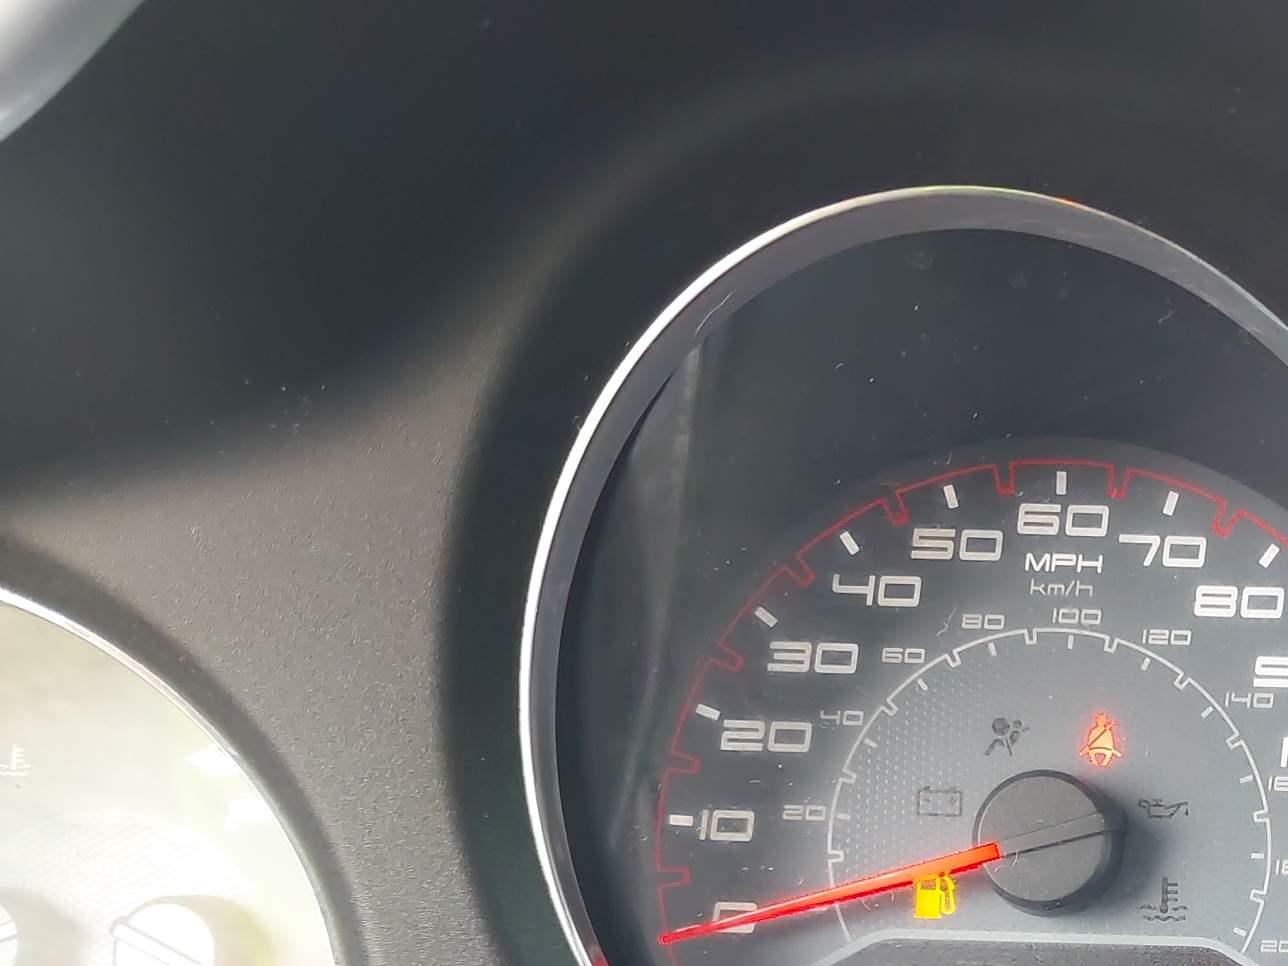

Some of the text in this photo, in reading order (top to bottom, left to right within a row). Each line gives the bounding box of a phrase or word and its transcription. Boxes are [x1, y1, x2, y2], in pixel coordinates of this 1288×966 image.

[1017, 503, 1109, 536] 60
[911, 528, 1004, 561] 50
[1118, 534, 1207, 568] 70
[1025, 552, 1104, 574] MPH
[832, 575, 922, 607] 40
[1030, 578, 1094, 598] km/h
[1193, 585, 1285, 618] 80
[961, 613, 1005, 630] 80
[1052, 607, 1102, 625] 100
[1142, 629, 1191, 646] 120
[768, 641, 860, 674] 30
[881, 647, 925, 663] 60
[1225, 692, 1274, 709] 140
[820, 710, 865, 726] 40
[720, 720, 813, 752] 20
[782, 805, 826, 821] 20
[699, 809, 755, 842] 10
